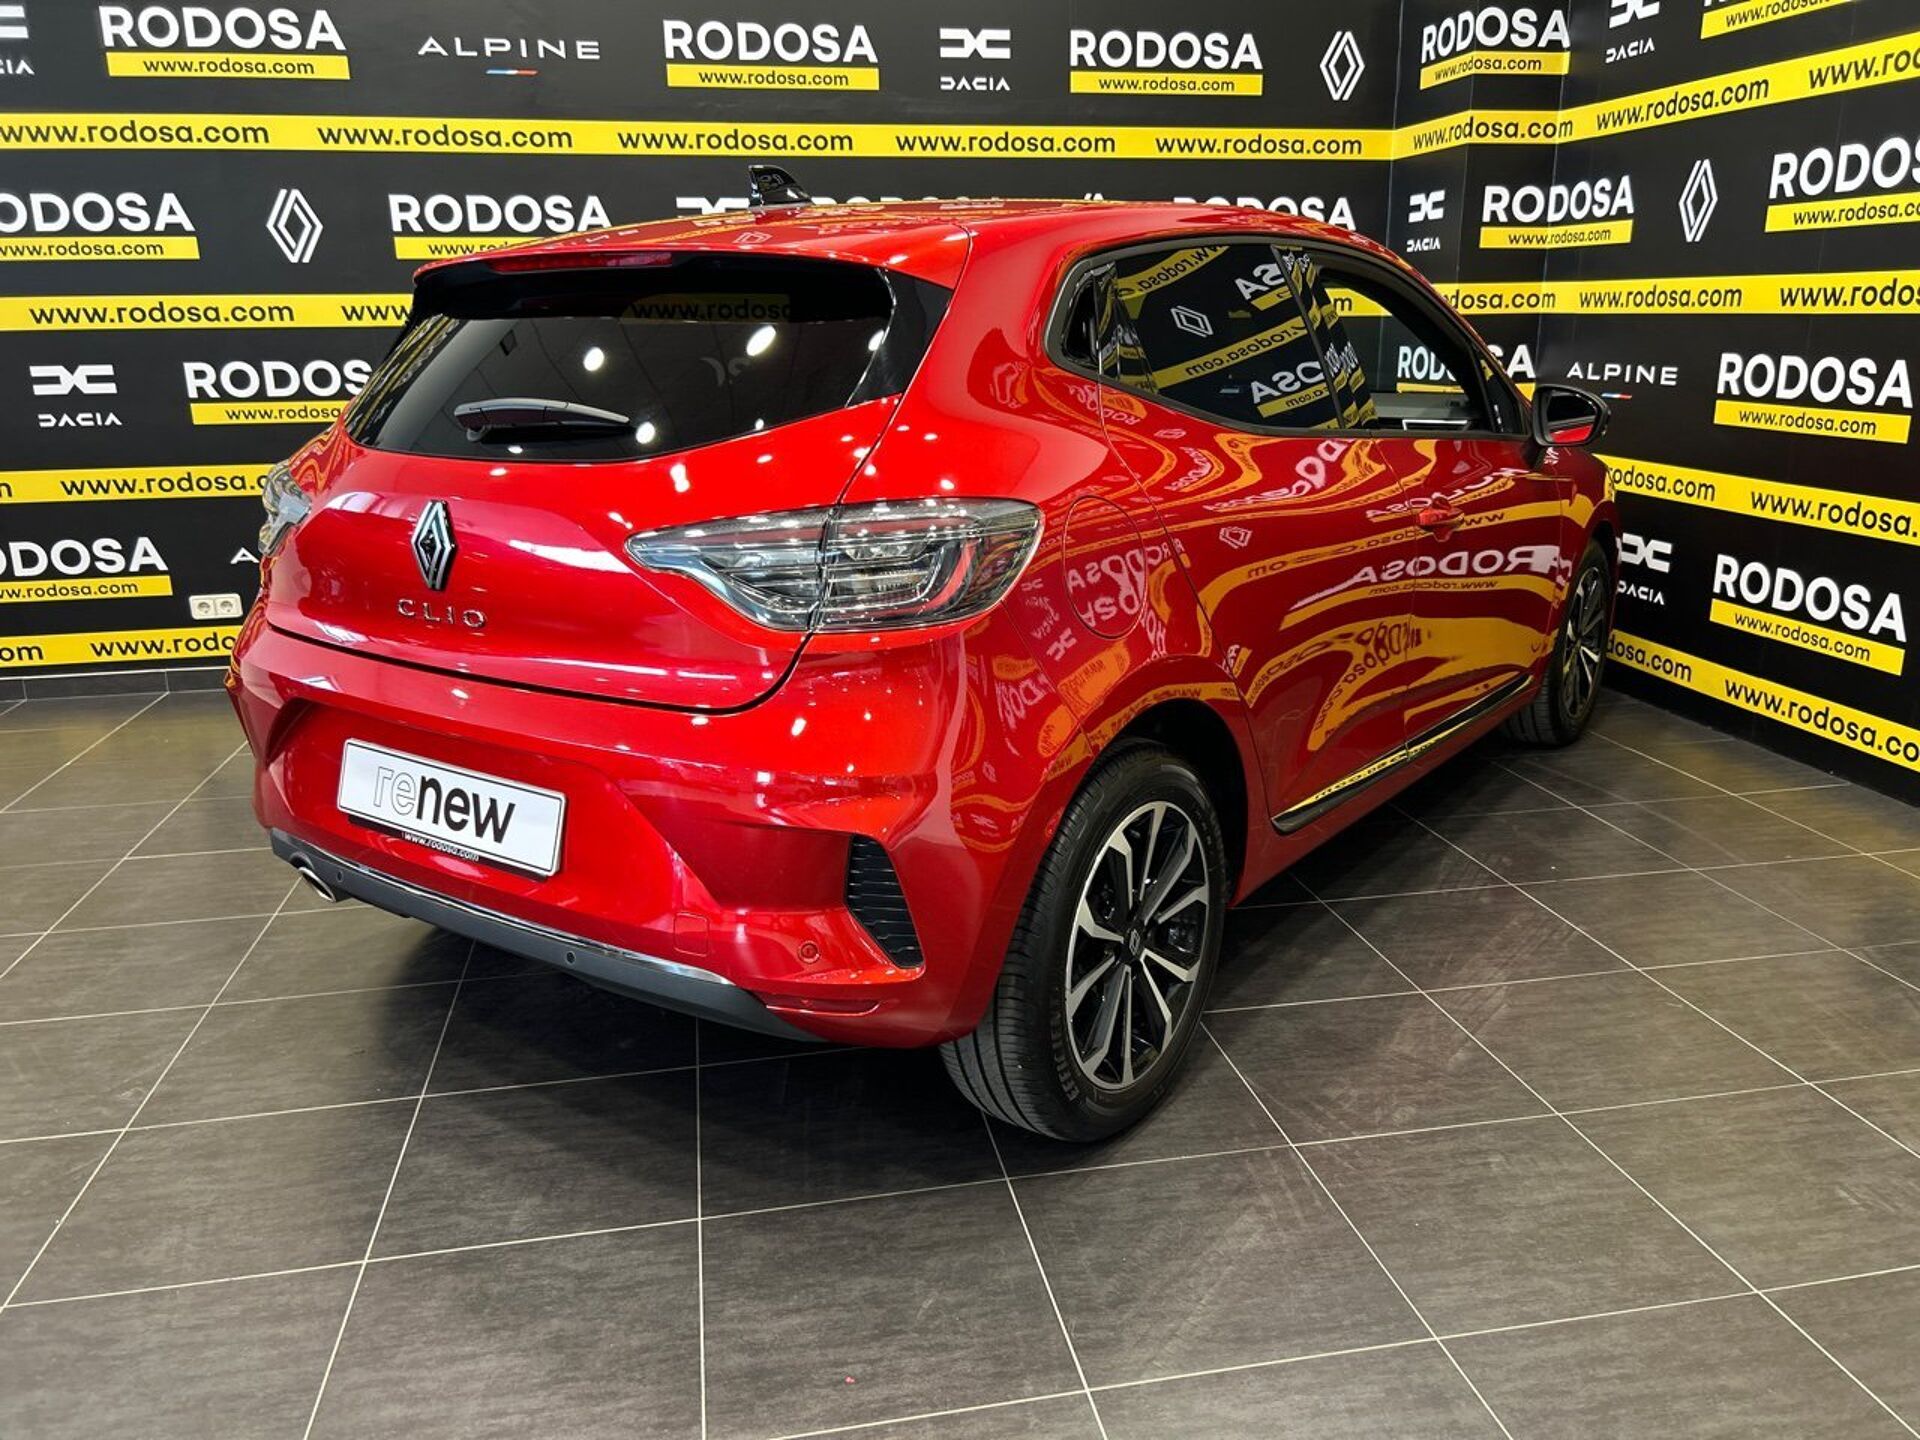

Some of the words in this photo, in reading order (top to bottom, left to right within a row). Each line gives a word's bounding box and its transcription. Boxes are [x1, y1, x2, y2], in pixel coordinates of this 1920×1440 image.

[99, 5, 346, 51] RODOSA
[662, 19, 878, 63] RODOSA
[1421, 6, 1571, 64] RODOSA
[418, 36, 600, 60] ALPINE
[1070, 30, 1263, 70] RODOSA
[1605, 37, 1656, 64] DACIA
[143, 58, 314, 75] www.rodosa.com
[698, 70, 849, 86] www.rodosa.com
[1435, 56, 1542, 81] www.rodosa.com
[940, 76, 1010, 92] DACIA
[1099, 77, 1235, 92] www.rodosa.com
[1413, 116, 1573, 149] www.rodosa.com
[1597, 78, 1769, 130] www.rodosa.com
[0, 120, 270, 144] www.rodosa.com
[317, 124, 573, 148] www.rodosa.com
[617, 129, 853, 151] www.rodosa.com
[896, 131, 1116, 153] www.rodosa.com
[1155, 134, 1362, 155] www.rodosa.com
[1482, 175, 1634, 223] RODOSA
[388, 193, 612, 233] RODOSA
[1406, 237, 1441, 252] DACIA
[1508, 229, 1611, 245] www.rodosa.com
[1579, 285, 1743, 308] www.rodosa.com
[29, 301, 295, 325] www.rodosa.com
[1567, 361, 1679, 386] ALPINE
[1717, 352, 1914, 409] RODOSA
[38, 412, 122, 427] DACIA
[1739, 408, 1877, 435] www.rodosa.com
[1713, 554, 1907, 643] RODOSA
[396, 598, 487, 630] CLIO
[1734, 612, 1871, 662] www.rodosa.com
[373, 766, 516, 844] renew
